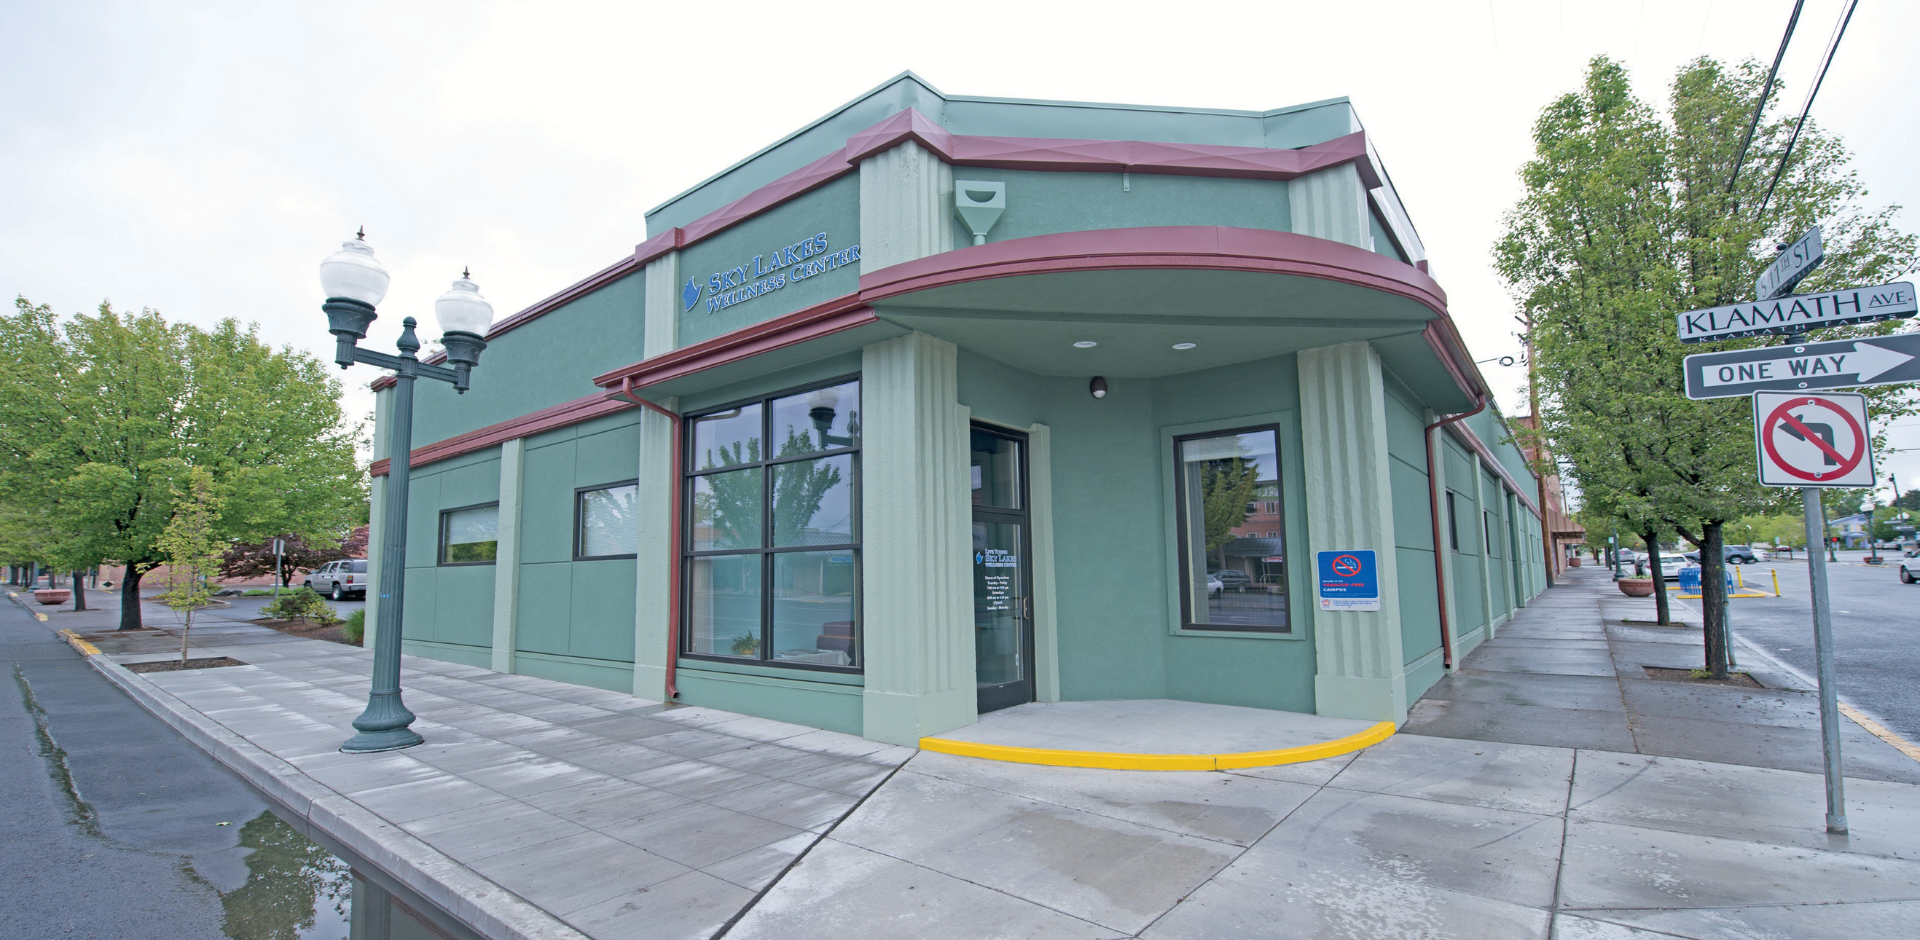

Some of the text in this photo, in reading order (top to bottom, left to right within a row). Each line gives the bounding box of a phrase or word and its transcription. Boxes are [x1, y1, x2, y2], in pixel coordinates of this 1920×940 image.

[705, 244, 860, 313] WELLNESS CENTER
[708, 232, 828, 295] SKY LAKES
[1760, 276, 1767, 298] S
[1793, 236, 1811, 268] ST
[1685, 290, 1907, 334] KLAMATH AVE
[1699, 314, 1897, 342] KLAMATH FALLS
[1718, 355, 1847, 383] ONE WAY
[985, 554, 1017, 562] SKY LAKES
